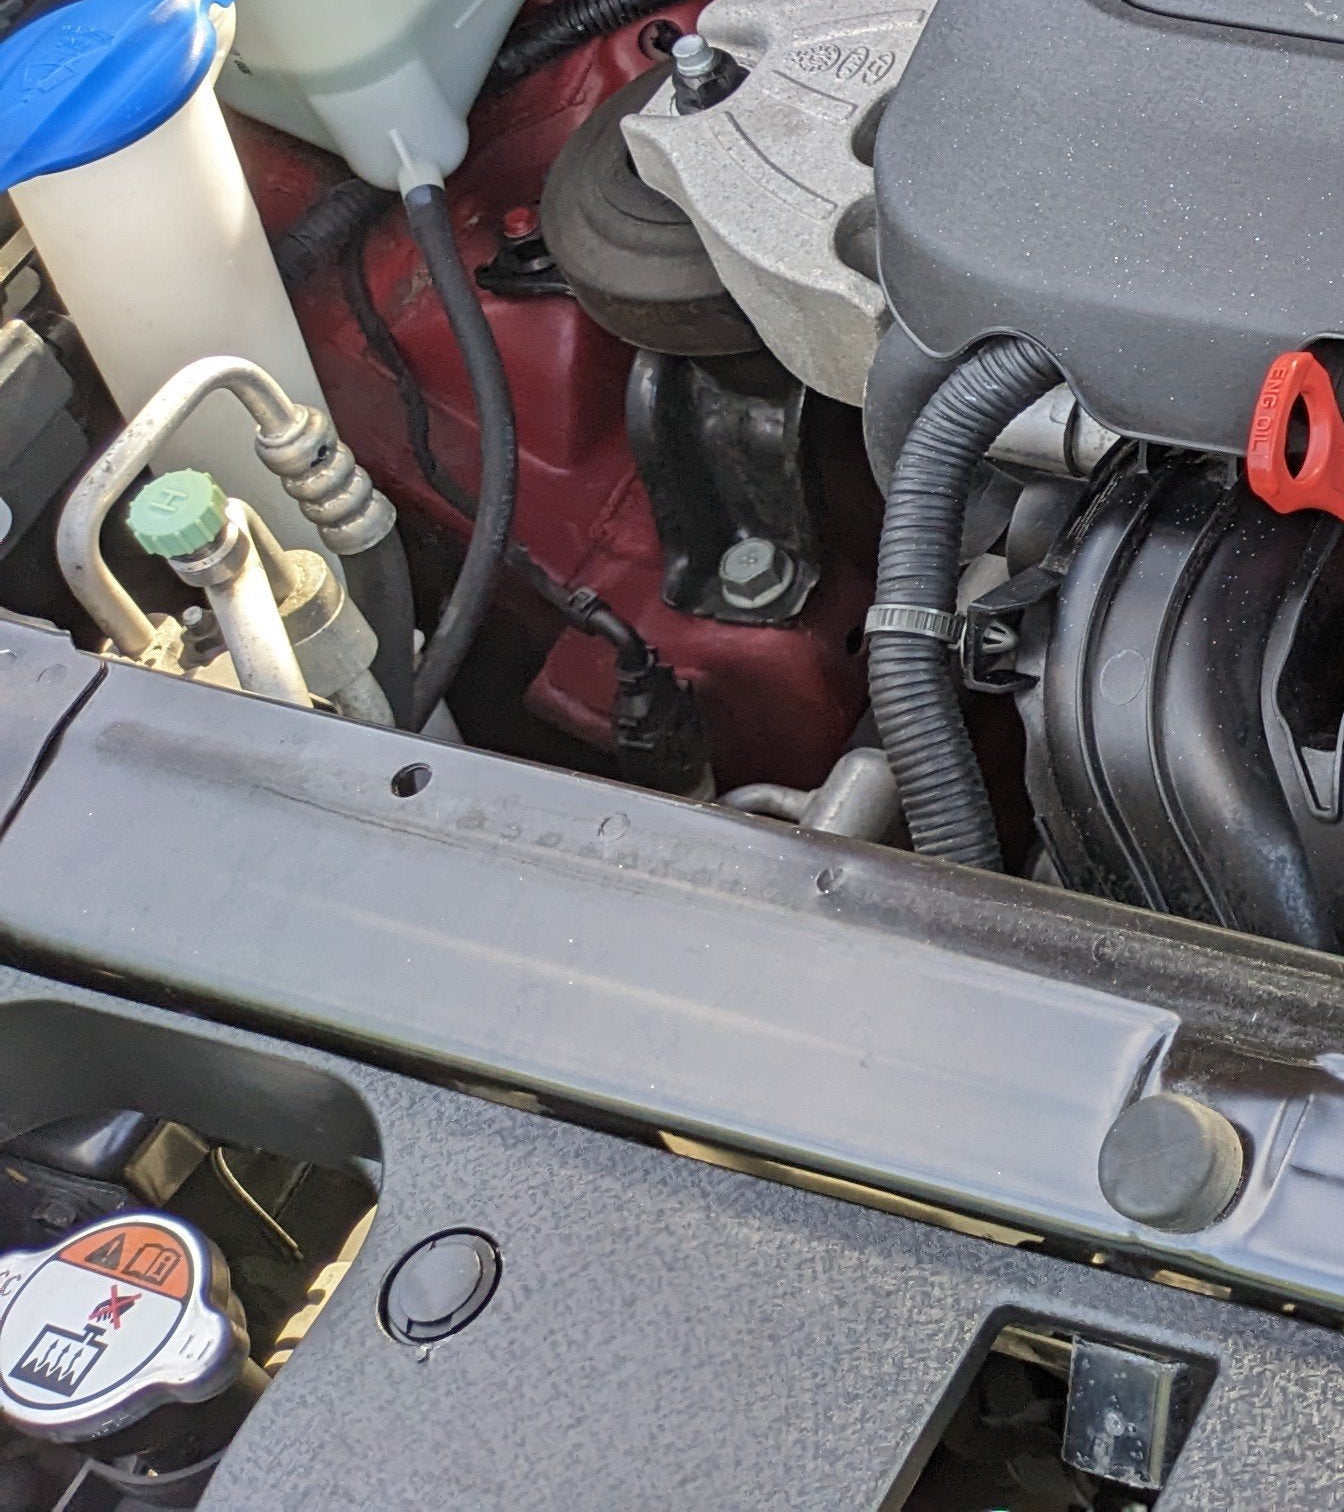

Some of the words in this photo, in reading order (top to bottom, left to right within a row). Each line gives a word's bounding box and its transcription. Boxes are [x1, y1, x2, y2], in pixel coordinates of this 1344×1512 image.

[1261, 369, 1284, 409] ENG
[1252, 414, 1273, 451] OIL
[149, 488, 189, 513] H
